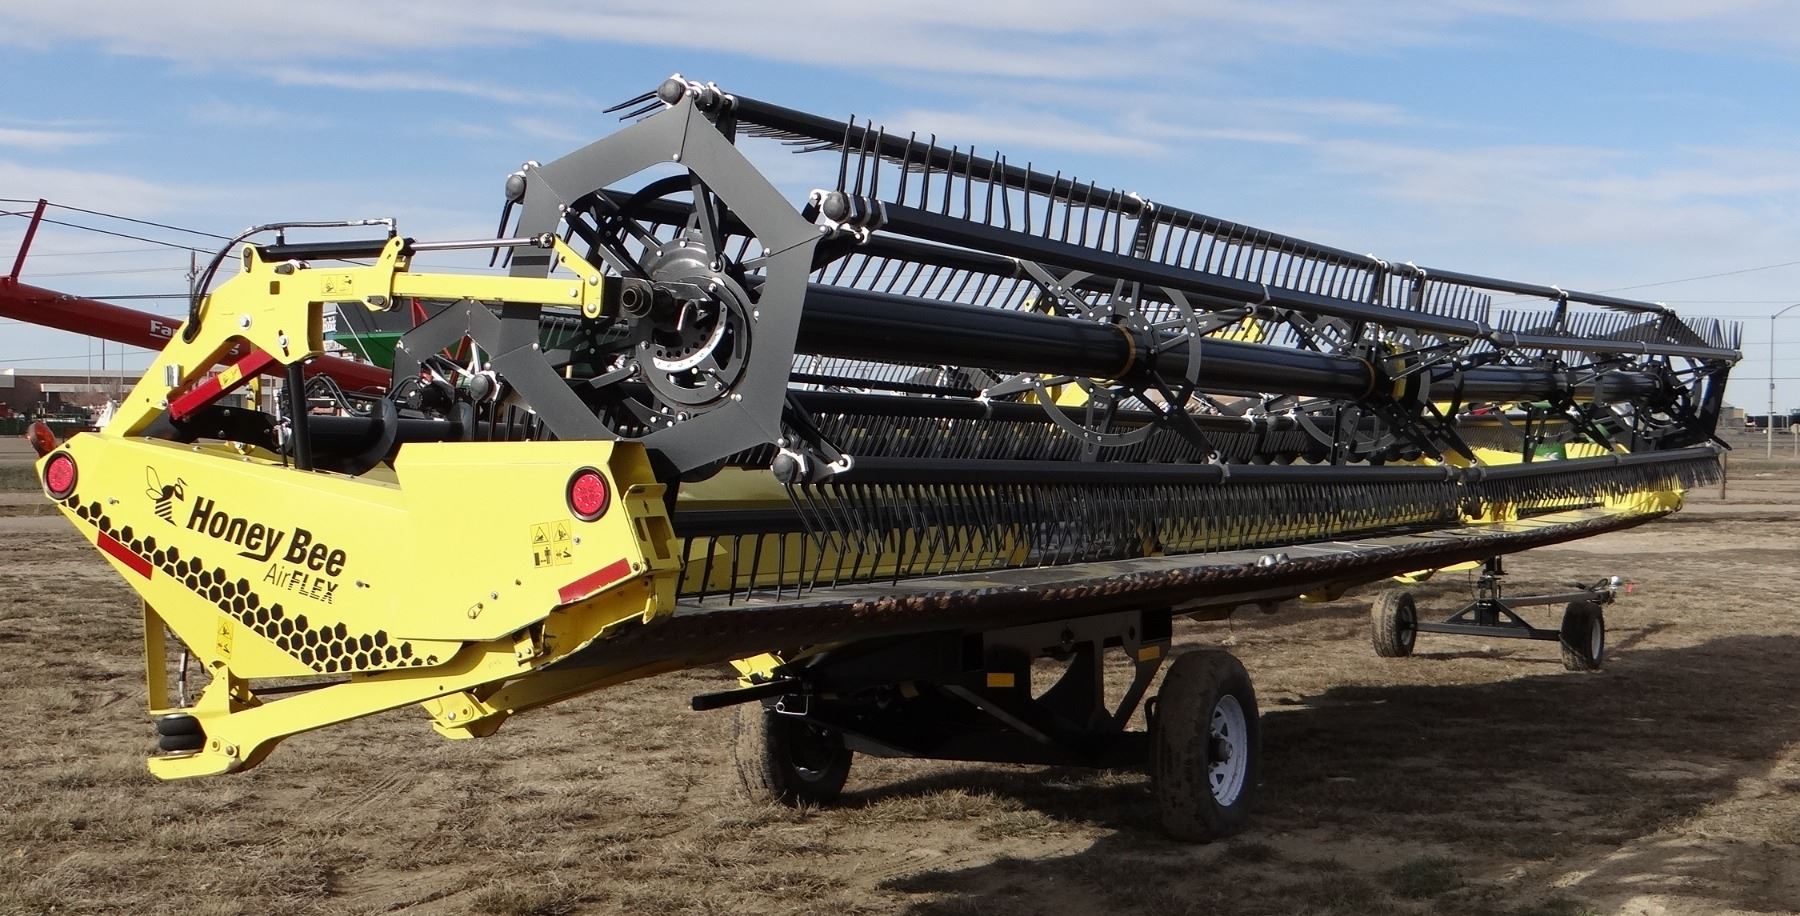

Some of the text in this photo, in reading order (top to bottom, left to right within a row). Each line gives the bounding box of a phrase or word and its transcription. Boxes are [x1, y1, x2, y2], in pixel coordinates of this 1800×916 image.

[186, 496, 346, 577] Honey Bee
[263, 563, 338, 604] AirFLEX
